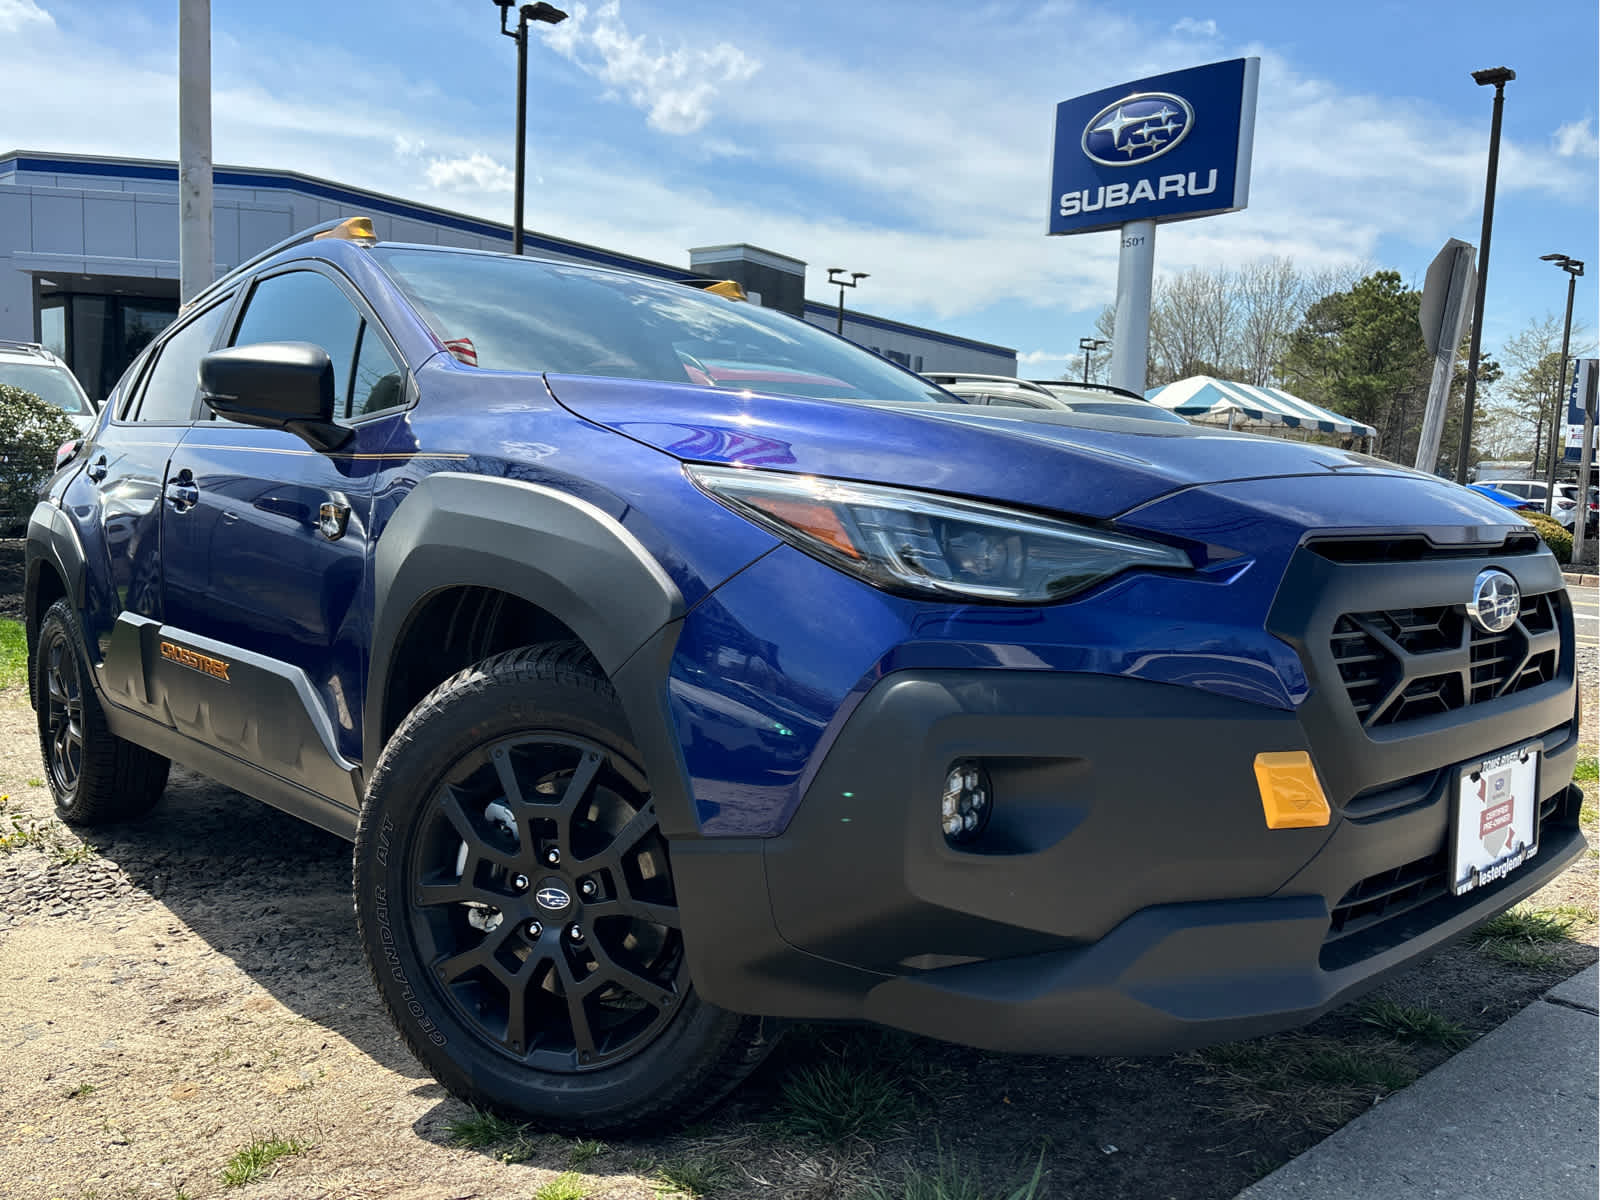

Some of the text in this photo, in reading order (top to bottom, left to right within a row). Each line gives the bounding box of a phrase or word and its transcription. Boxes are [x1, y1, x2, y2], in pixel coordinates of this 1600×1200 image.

[1060, 169, 1217, 216] SUBARU
[1121, 236, 1145, 249] 1501
[160, 641, 230, 680] CROSSTREK
[375, 815, 447, 1047] GEOLANDAR A/T
